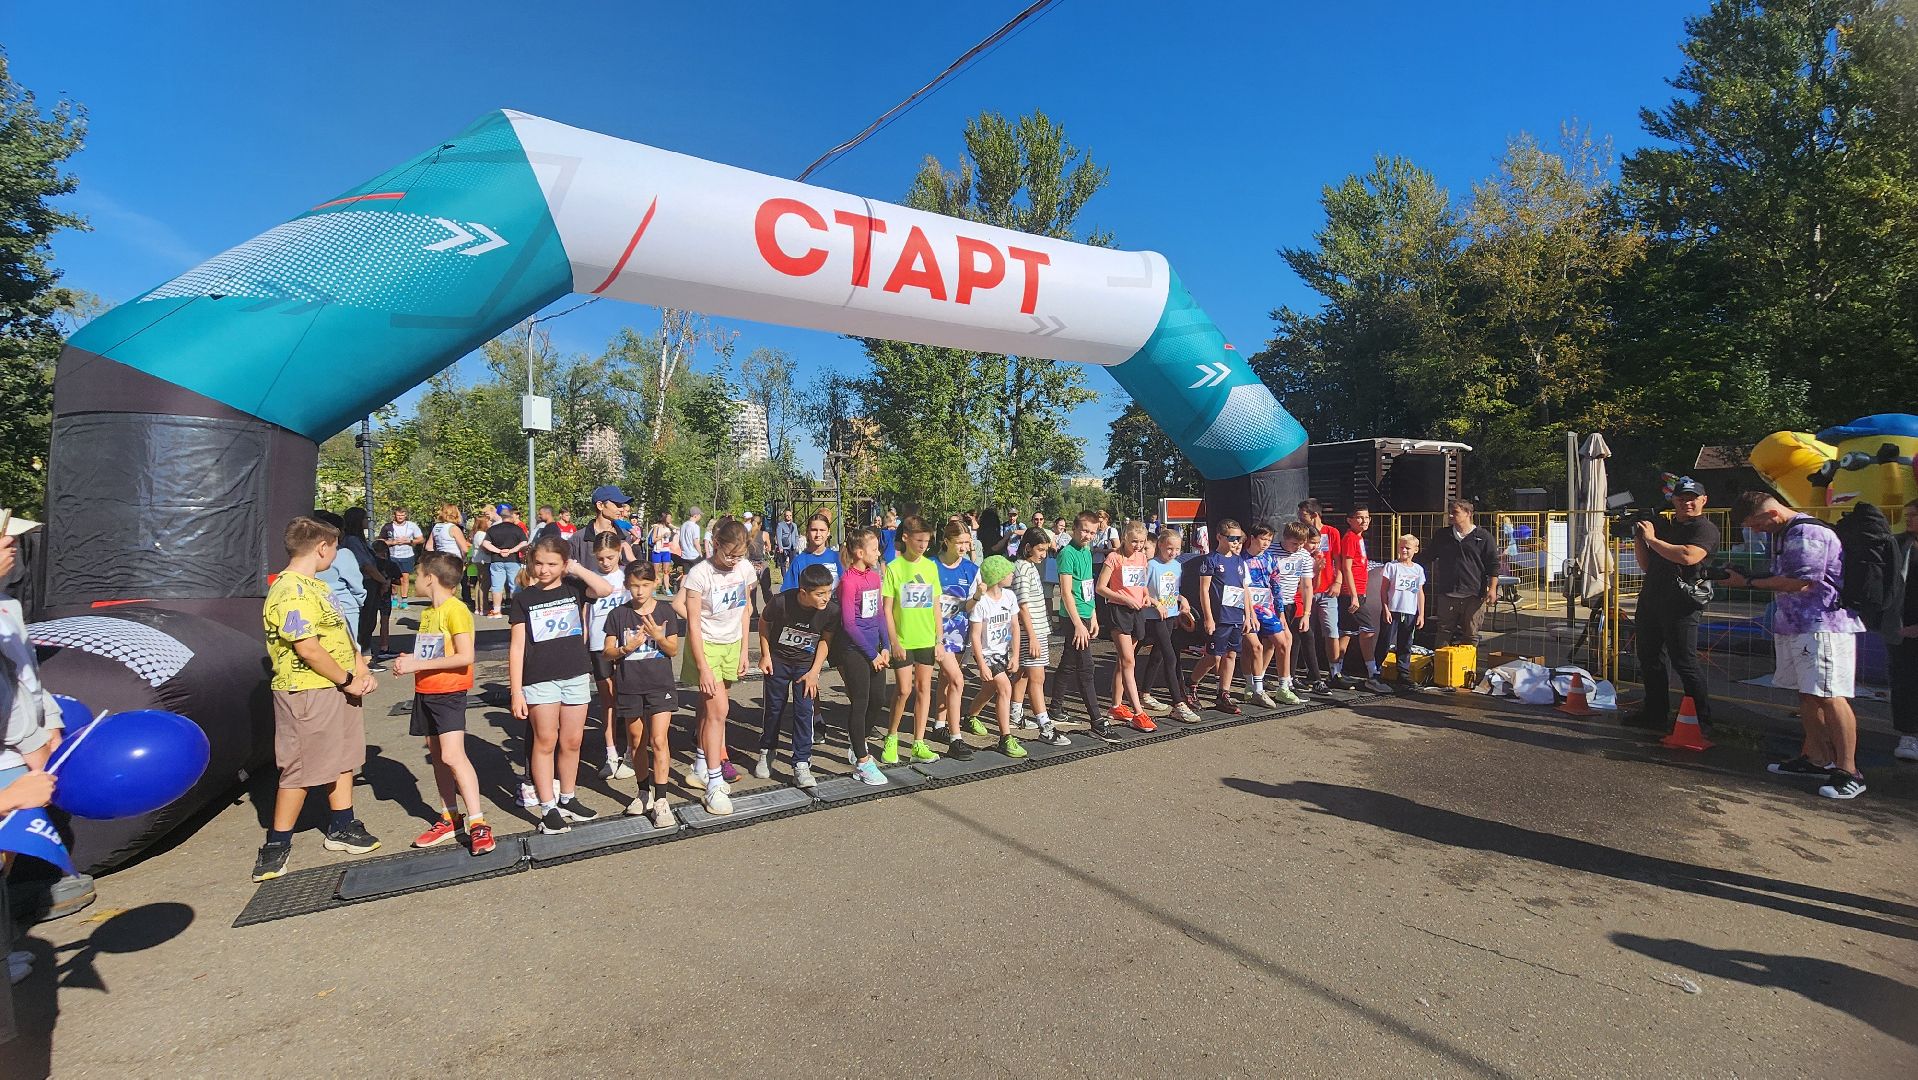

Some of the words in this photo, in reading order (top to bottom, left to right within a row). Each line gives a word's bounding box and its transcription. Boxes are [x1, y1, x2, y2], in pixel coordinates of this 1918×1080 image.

[755, 198, 1050, 315] СТАРТ
[1284, 562, 1295, 571] 81
[1129, 573, 1139, 583] 29
[1165, 582, 1175, 592] 93
[721, 590, 738, 605] 44
[906, 591, 927, 603] 156
[1232, 593, 1239, 603] 7
[545, 617, 569, 632] 96
[785, 633, 813, 646] 105
[990, 628, 1008, 641] 230
[421, 644, 435, 659] 37
